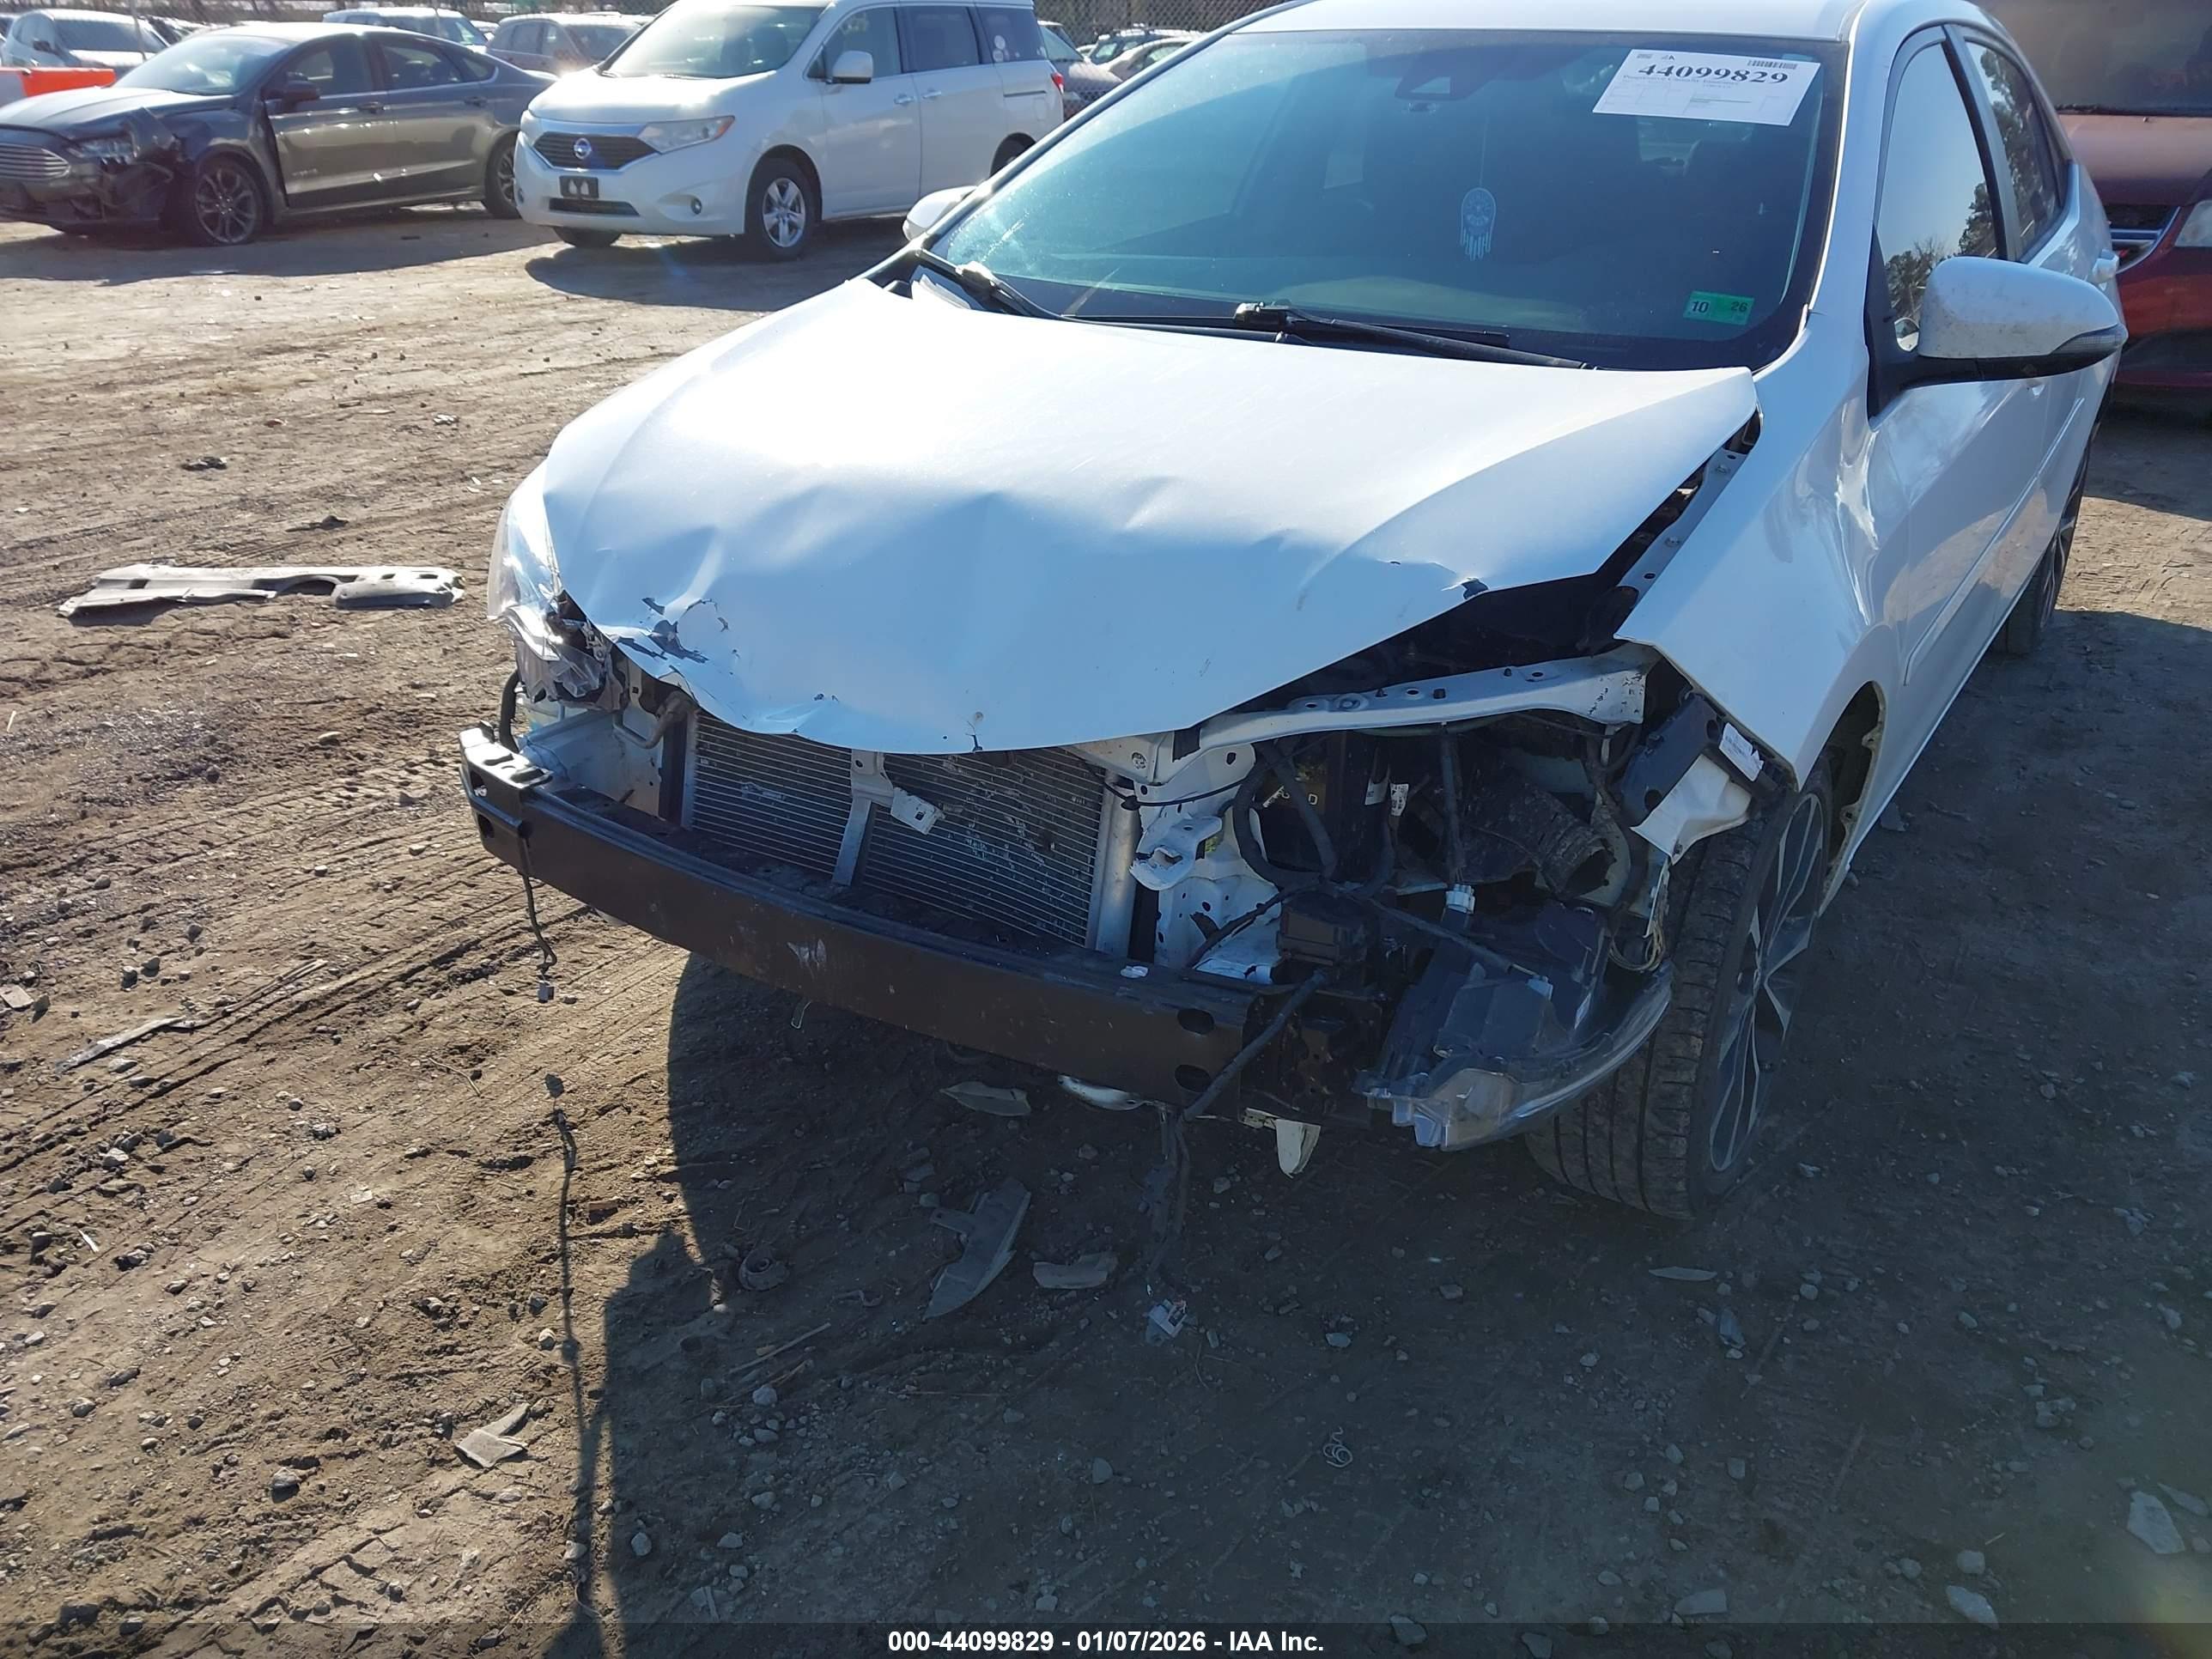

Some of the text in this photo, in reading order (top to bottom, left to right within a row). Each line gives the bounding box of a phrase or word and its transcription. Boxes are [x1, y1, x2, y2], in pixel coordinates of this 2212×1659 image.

[1638, 64, 1789, 84] 44099829
[1691, 301, 1748, 313] 10 26
